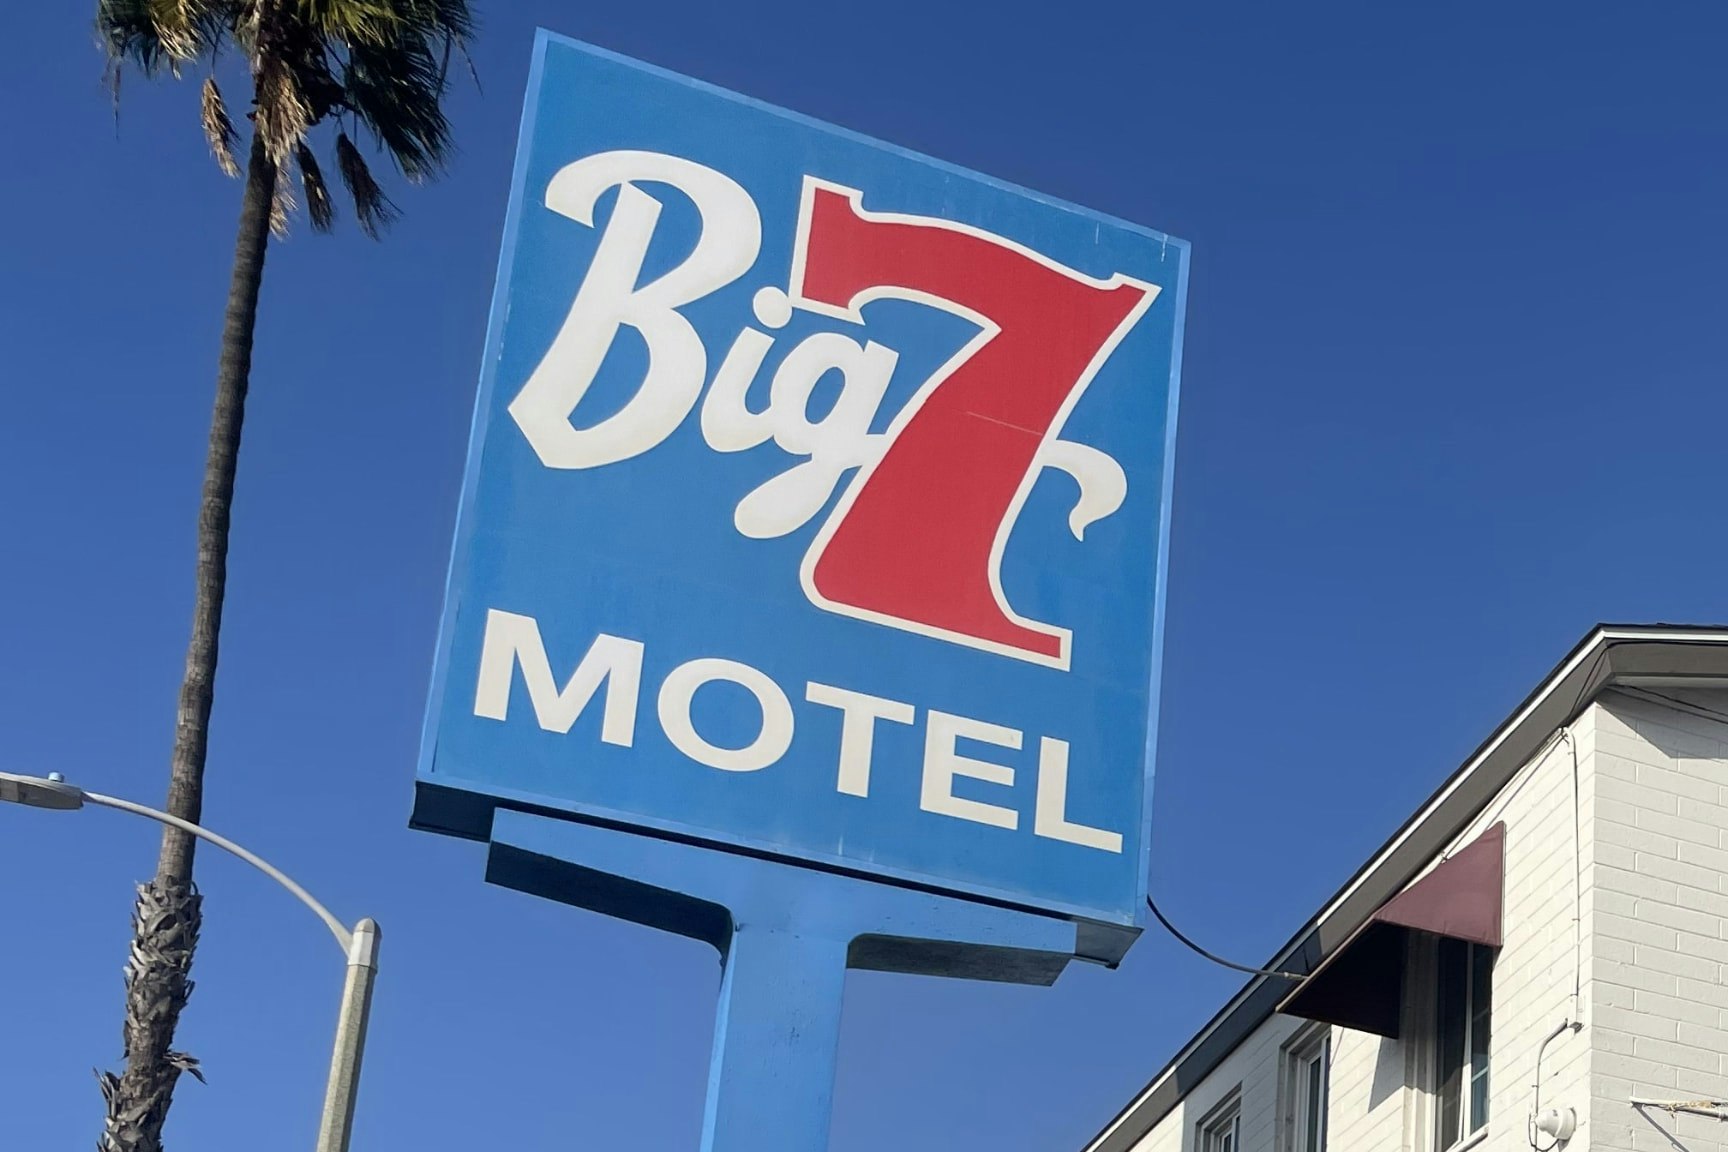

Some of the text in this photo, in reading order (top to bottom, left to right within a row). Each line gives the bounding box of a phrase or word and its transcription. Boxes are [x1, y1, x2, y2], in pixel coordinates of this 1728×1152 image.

[507, 149, 1162, 672] Big 7
[473, 607, 1124, 854] MOTEL
